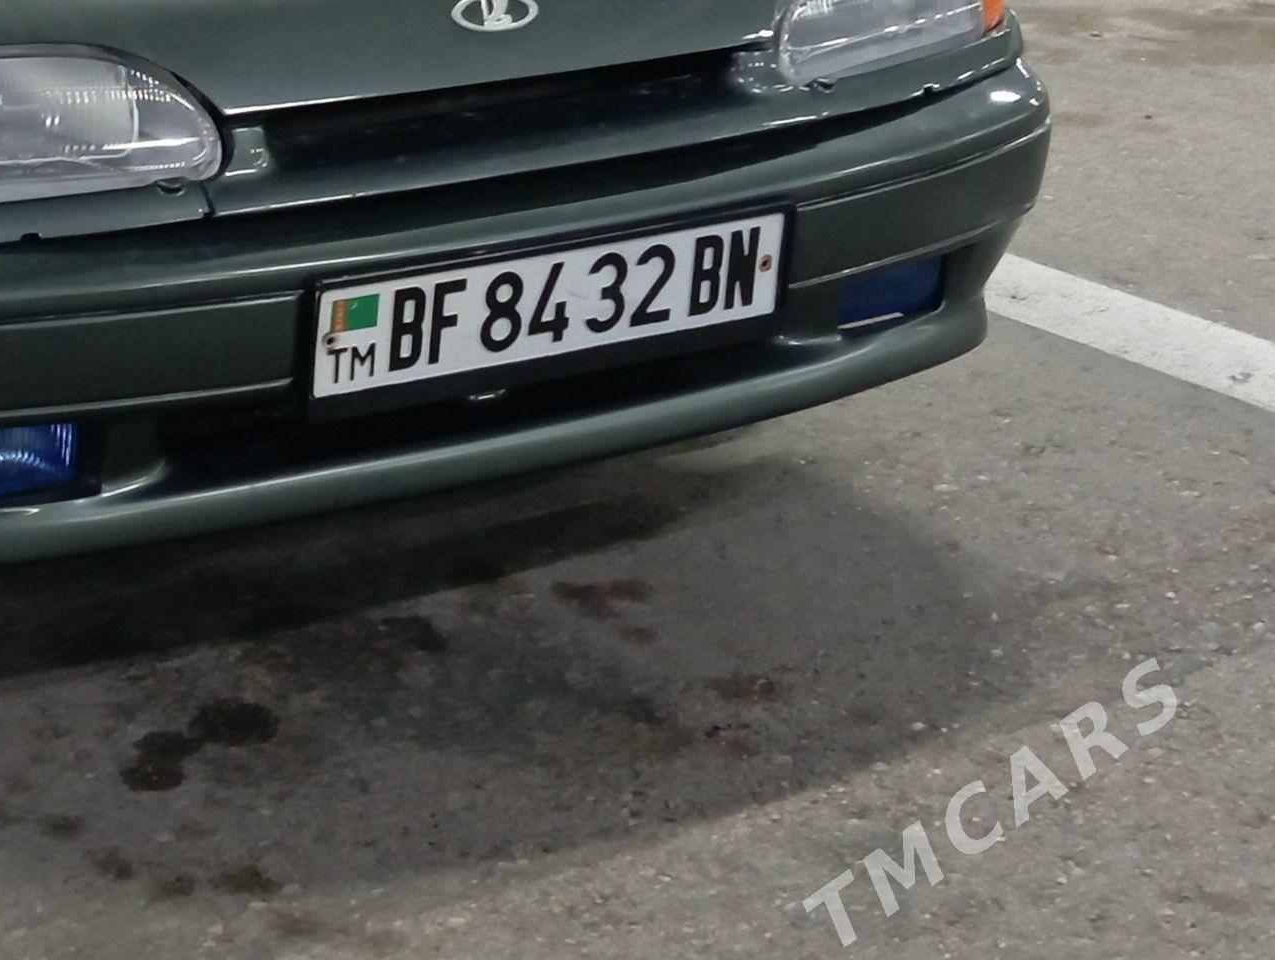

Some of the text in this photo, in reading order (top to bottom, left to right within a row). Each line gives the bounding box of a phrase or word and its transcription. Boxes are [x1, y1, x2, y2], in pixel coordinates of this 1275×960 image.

[388, 278, 468, 373] BF
[688, 226, 761, 317] BN
[326, 342, 376, 384] TM
